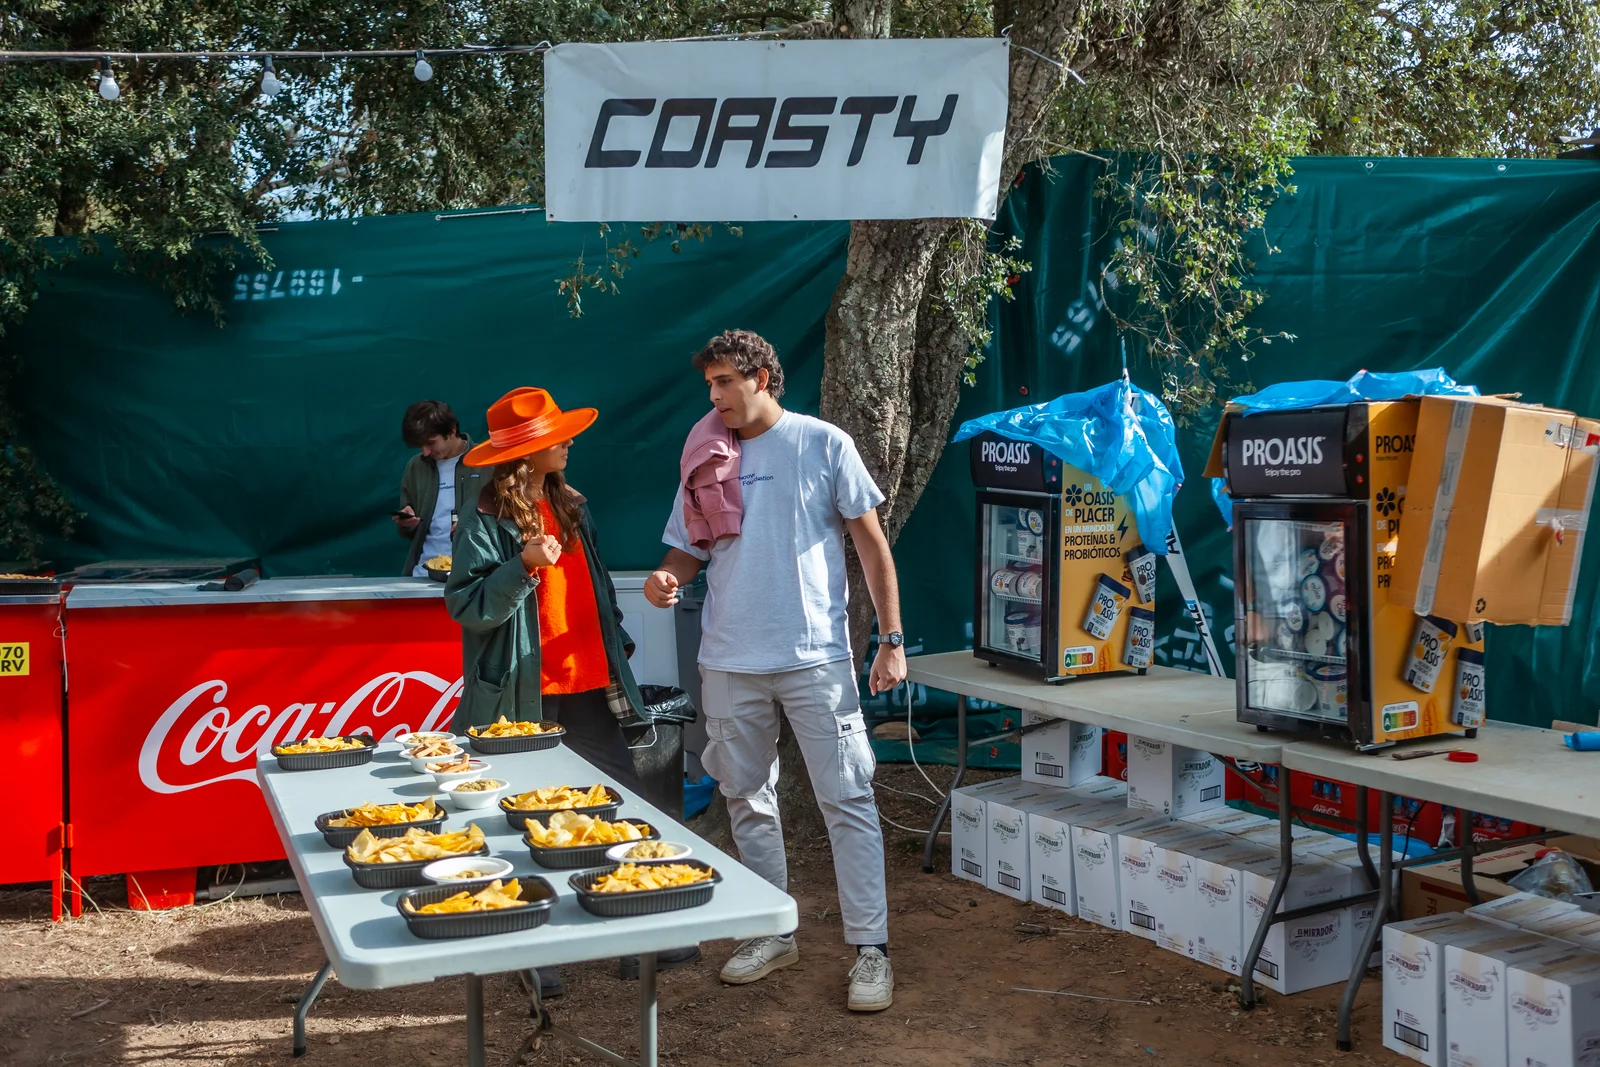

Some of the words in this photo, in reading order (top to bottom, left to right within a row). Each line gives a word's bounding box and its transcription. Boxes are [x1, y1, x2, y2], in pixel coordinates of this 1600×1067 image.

[584, 93, 960, 169] COASTY
[1242, 436, 1324, 466] PROASIS
[1375, 434, 1416, 454] PROAS
[981, 441, 1031, 464] PROASIS
[1264, 468, 1279, 477] Enjoy
[1290, 469, 1301, 477] pro
[1084, 490, 1115, 506] OASIS
[1074, 508, 1115, 523] PLACER
[1064, 526, 1072, 534] EN
[1073, 525, 1081, 533] UN
[1082, 524, 1106, 533] MUNDO
[1106, 524, 1115, 532] DE
[1064, 532, 1108, 546] PROTEÍNAS
[1109, 534, 1115, 544] &
[1064, 546, 1120, 560] PROBIÓTICOS
[1136, 561, 1152, 574] PRO
[1146, 570, 1155, 581] AS
[1098, 593, 1114, 609] PRO
[1101, 608, 1115, 621] ASIS
[1132, 625, 1149, 638] PRO
[1138, 639, 1151, 648] ASIS
[1420, 631, 1438, 650] PRO
[0, 646, 24, 659] 70
[1423, 650, 1440, 667] ASIS
[1462, 671, 1480, 688] PRO
[1469, 688, 1484, 701] ASIS
[1385, 717, 1390, 726] A
[1294, 929, 1303, 938] EL
[1303, 924, 1334, 938] MIRADOR
